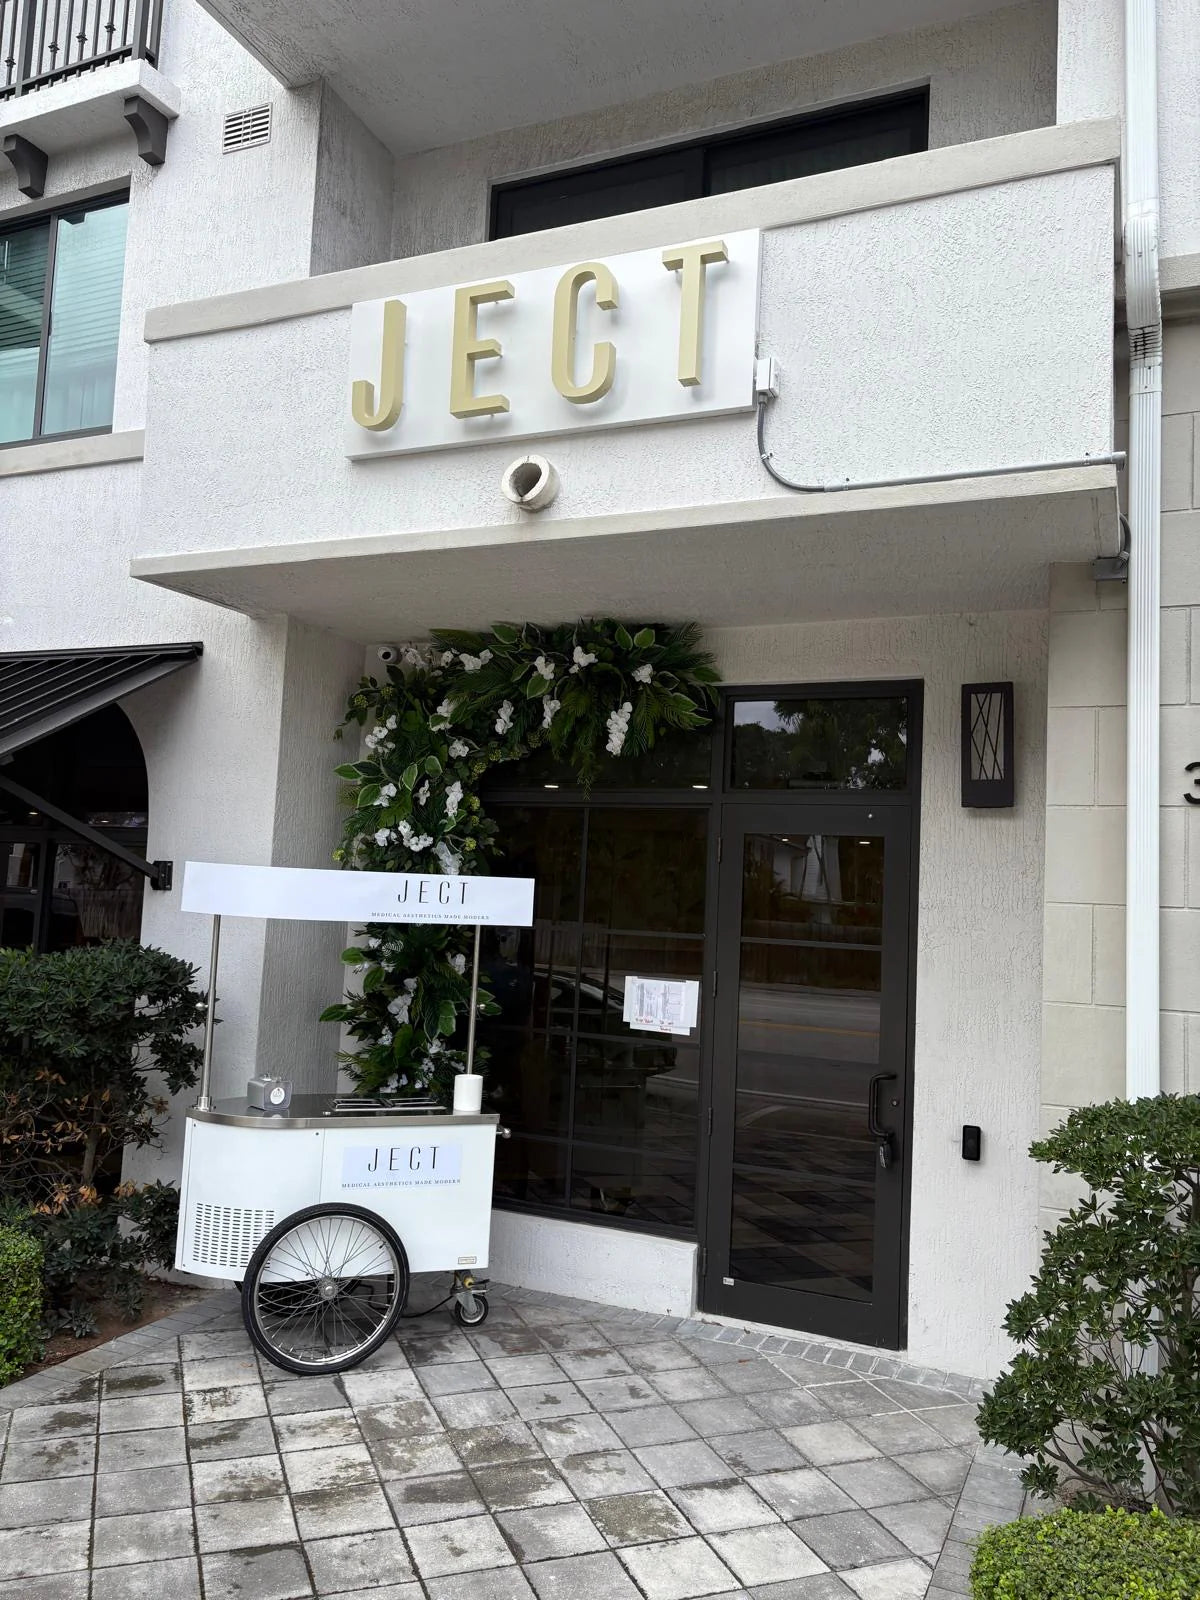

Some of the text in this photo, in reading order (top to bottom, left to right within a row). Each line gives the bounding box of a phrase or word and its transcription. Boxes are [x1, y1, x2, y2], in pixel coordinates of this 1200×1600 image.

[352, 240, 729, 432] JECT
[1183, 762, 1200, 804] 3
[398, 880, 469, 904] JECT
[368, 1146, 440, 1172] JECT
